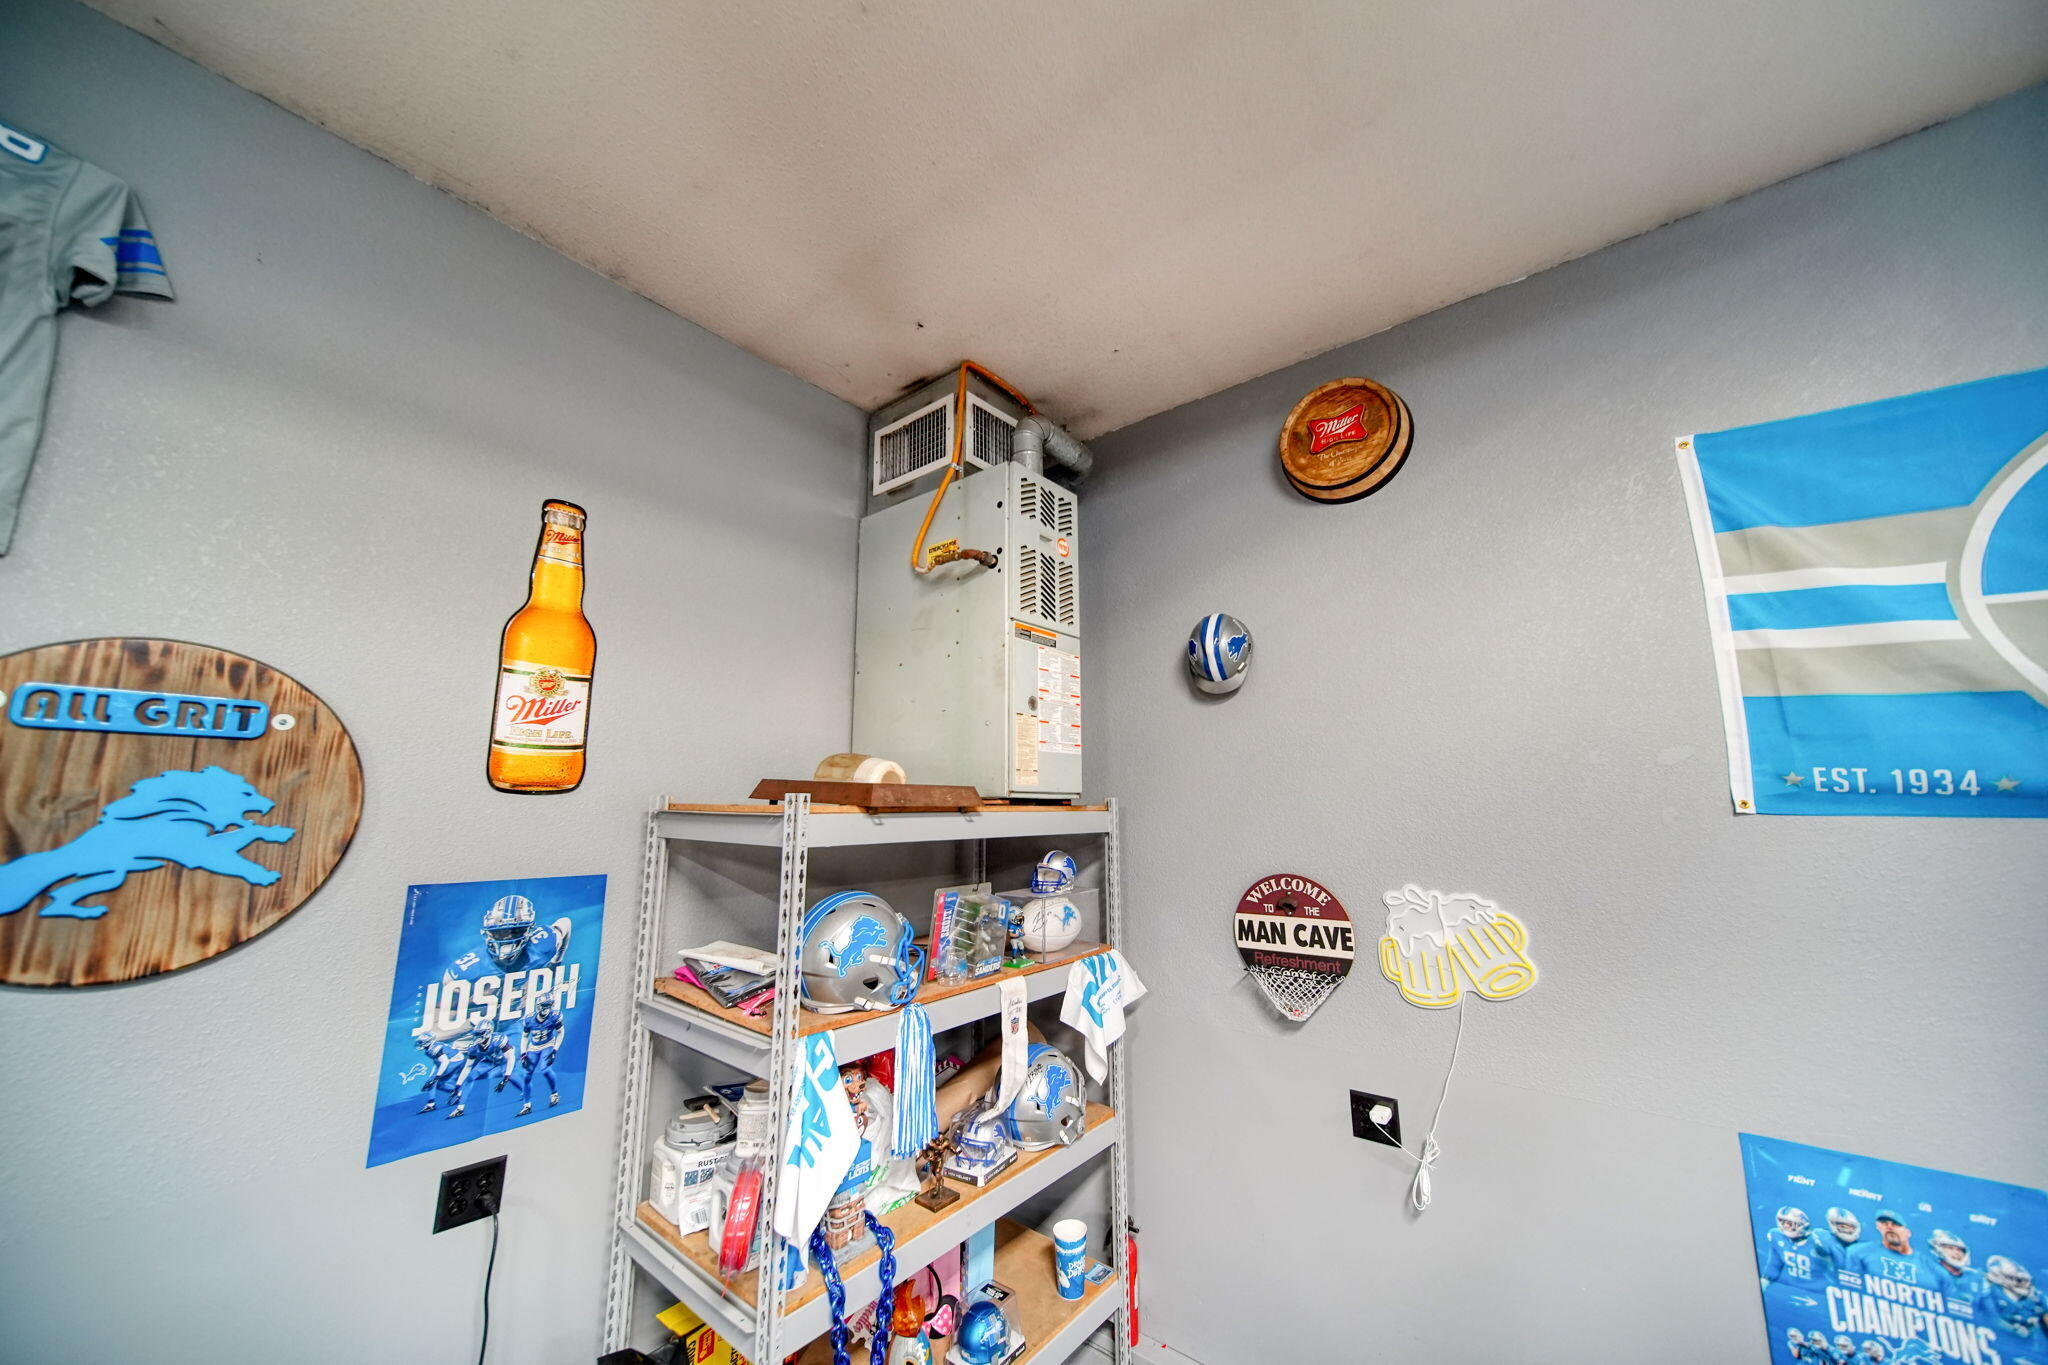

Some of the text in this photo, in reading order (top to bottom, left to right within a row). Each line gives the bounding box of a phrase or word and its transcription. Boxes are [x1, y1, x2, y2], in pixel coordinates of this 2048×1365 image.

[1316, 413, 1358, 438] Miller
[22, 689, 261, 732] ALL GRIT
[505, 695, 581, 723] Miller
[1812, 767, 1981, 796] EST. 1934
[1246, 877, 1331, 907] WELCOME
[1263, 903, 1320, 917] TO THE
[1238, 919, 1354, 952] MAN CAVE
[1254, 951, 1342, 974] Refreshment
[411, 963, 580, 1037] JOSEPH
[1864, 1273, 1945, 1314] NORTH
[1825, 1286, 2003, 1365] CHAMPIONS
